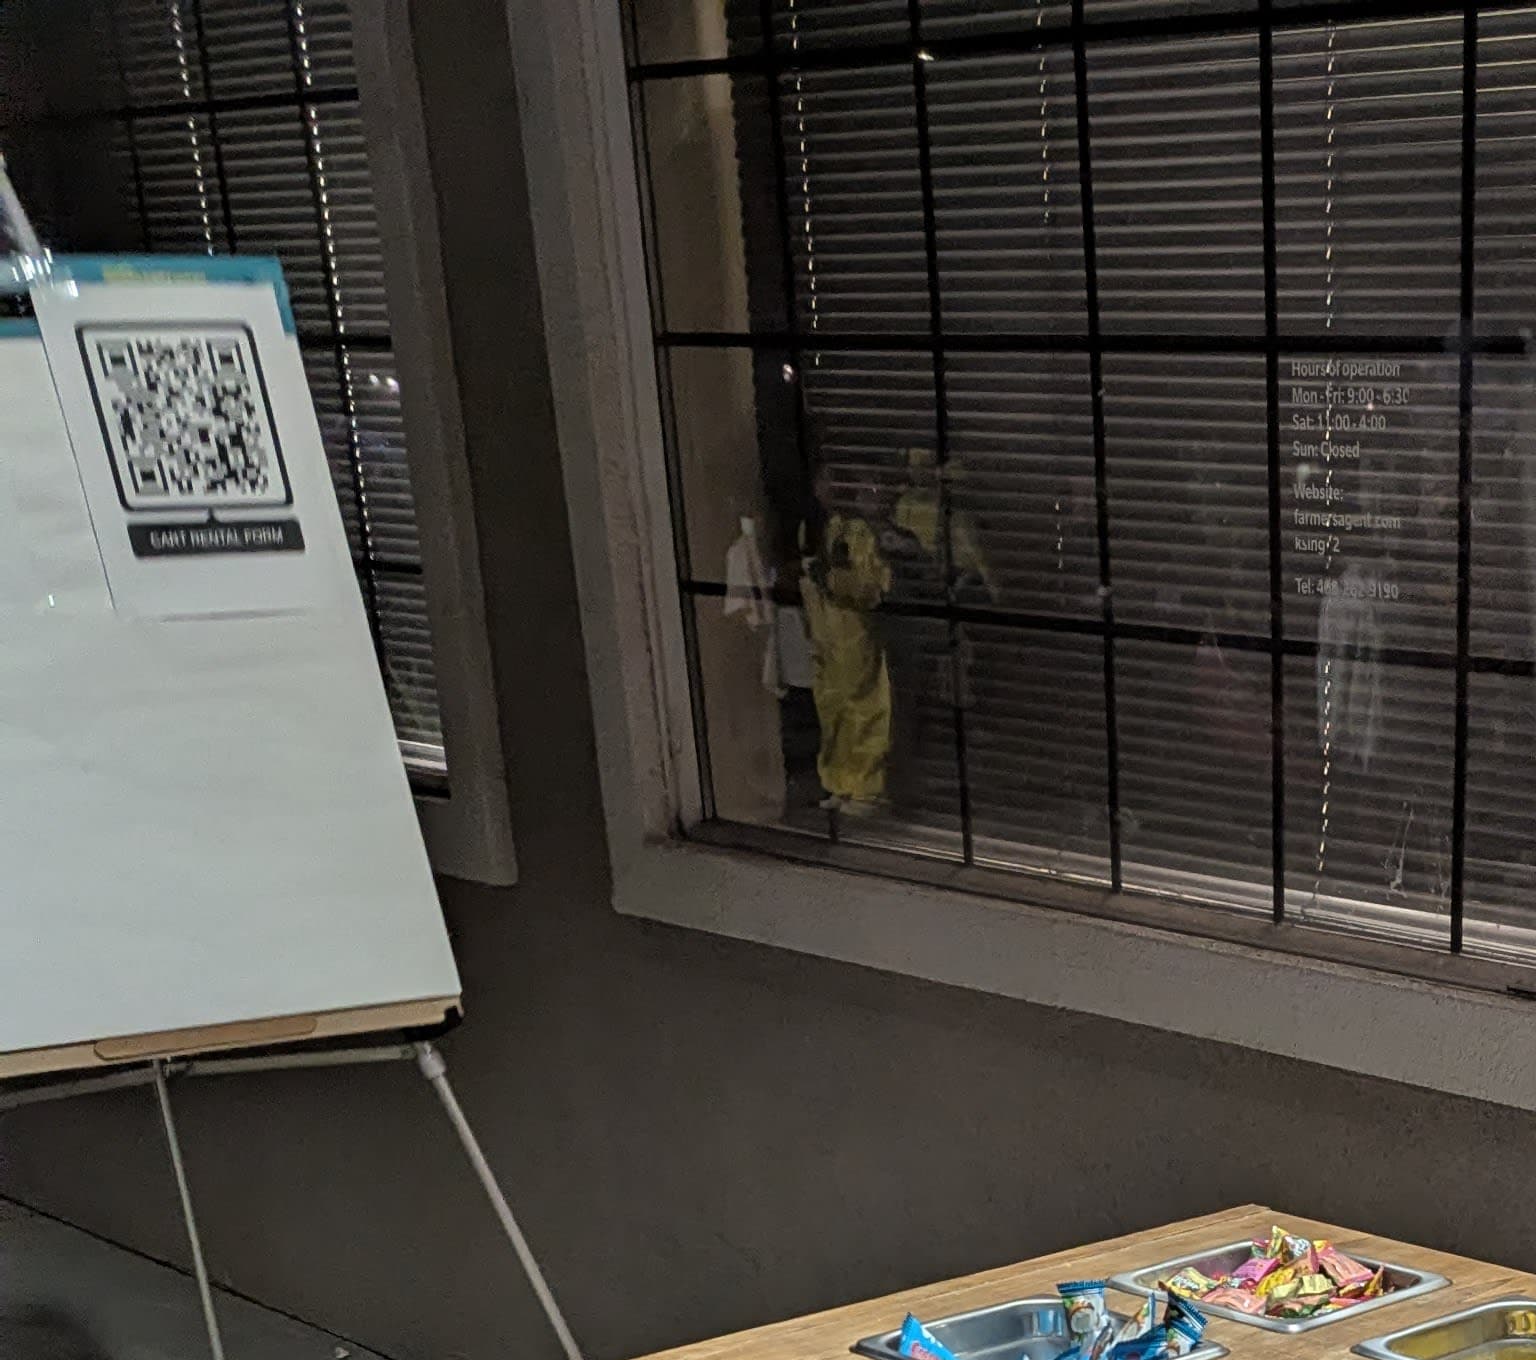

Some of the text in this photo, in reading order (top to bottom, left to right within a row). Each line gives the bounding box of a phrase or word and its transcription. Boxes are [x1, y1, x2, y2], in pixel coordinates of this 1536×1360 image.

[1291, 360, 1401, 380] Hours of operation
[1292, 387, 1318, 403] Mon
[1347, 387, 1375, 403] 9:00
[1383, 387, 1410, 404] 6:30
[1292, 414, 1315, 430] Sat:
[1359, 415, 1387, 431] 4:00
[1292, 441, 1360, 458] Sun: Closed
[1293, 482, 1344, 501] Website:
[1295, 577, 1315, 595] Tel:
